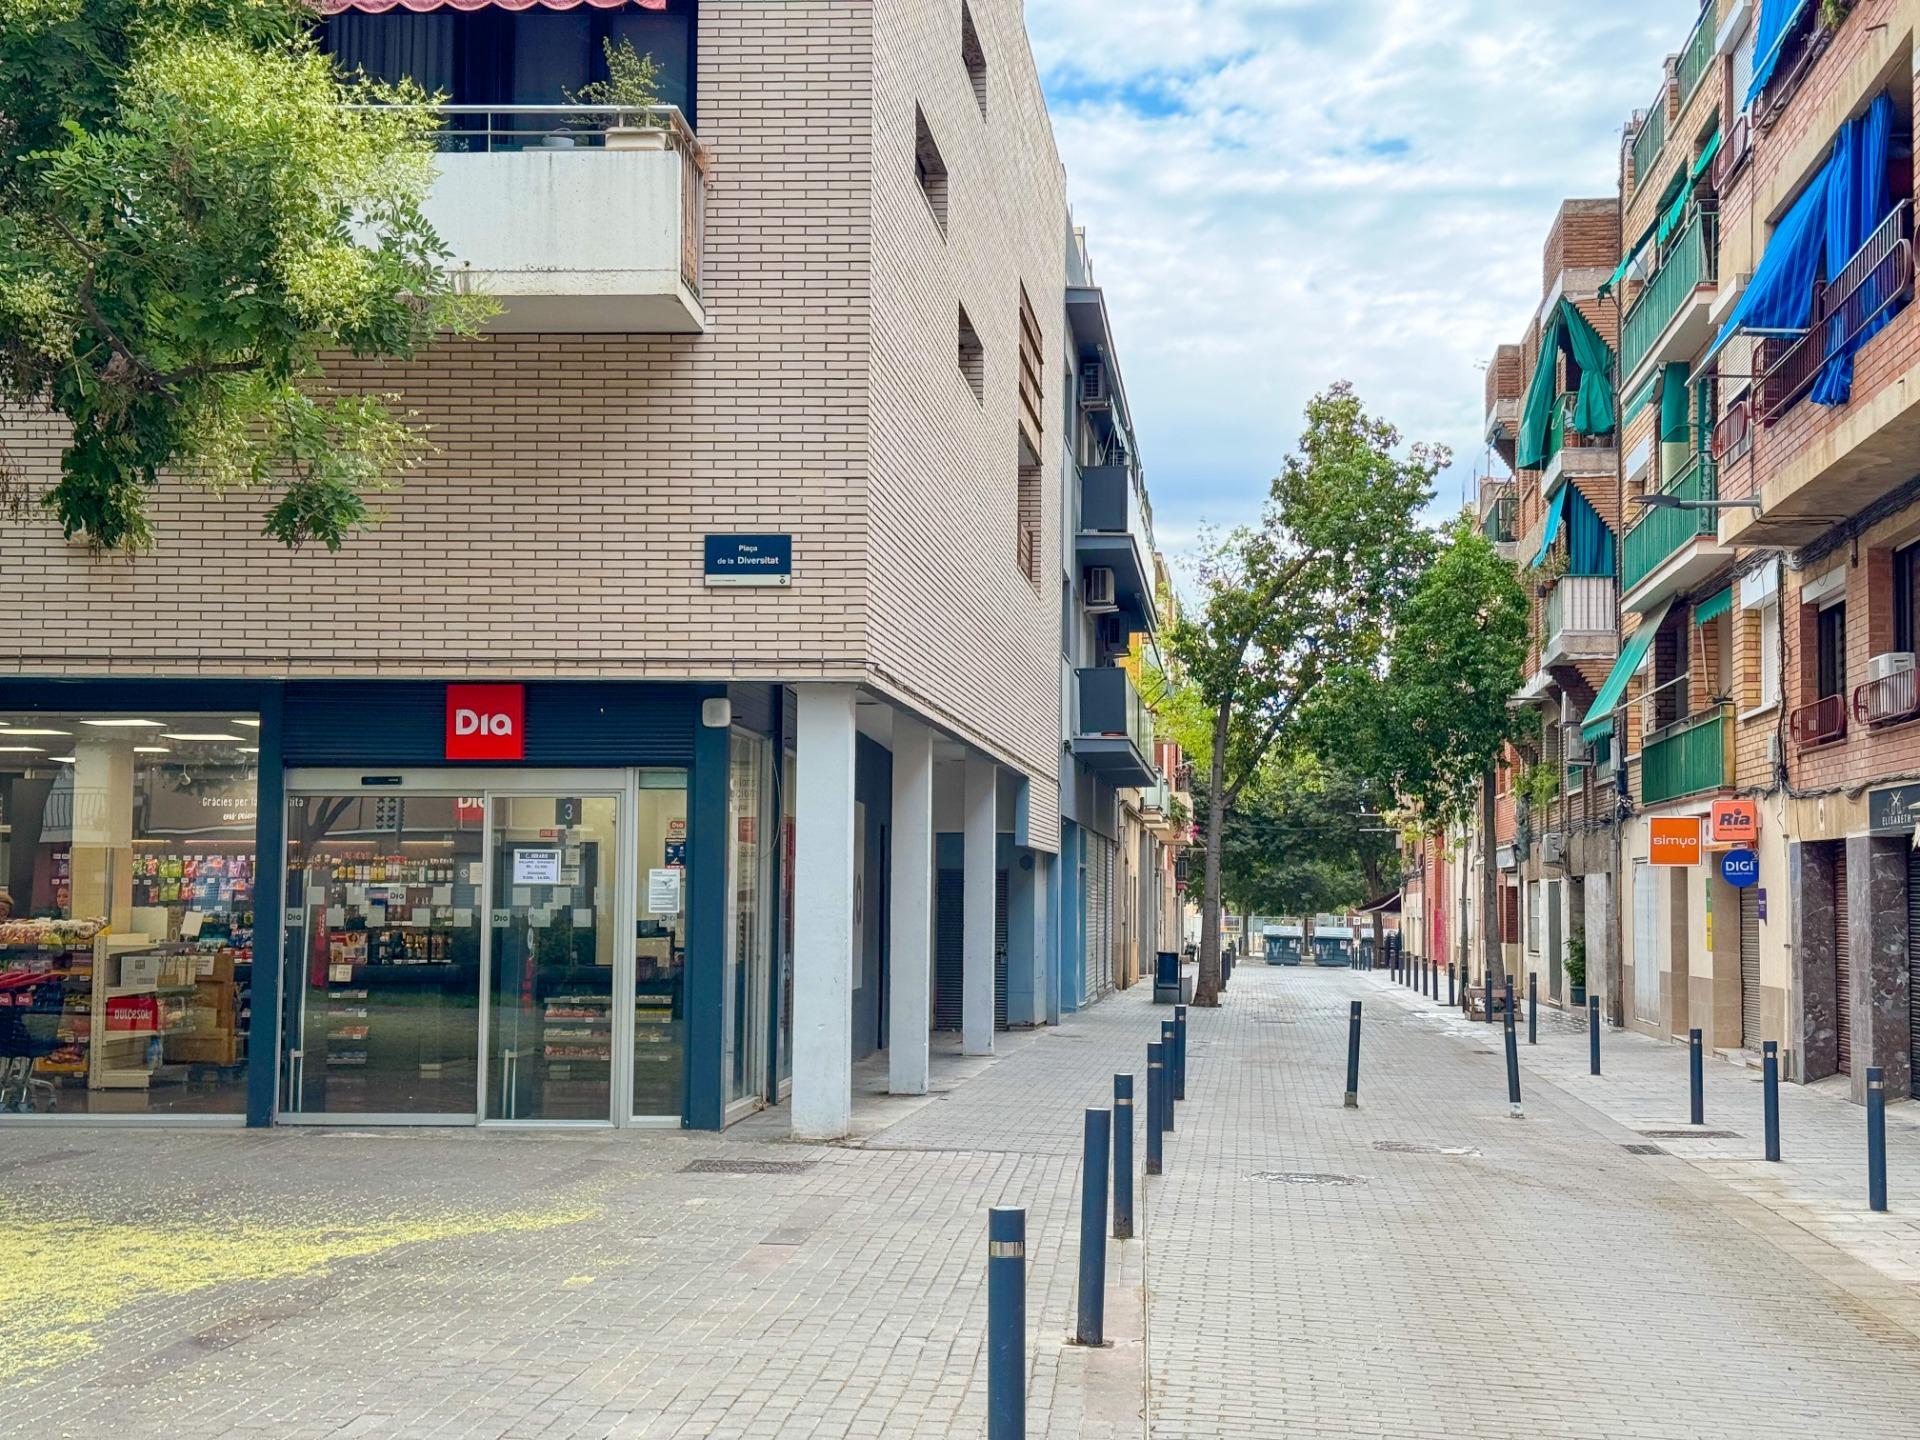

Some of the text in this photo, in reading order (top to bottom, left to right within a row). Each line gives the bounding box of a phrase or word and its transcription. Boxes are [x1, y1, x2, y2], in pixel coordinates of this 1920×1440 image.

[738, 544, 758, 553] Plaça
[717, 556, 779, 565] de la Diversitat
[455, 708, 513, 736] Dia
[202, 796, 233, 807] Gràcies
[234, 798, 248, 809] per
[564, 803, 574, 820] 3
[1719, 808, 1751, 826] Ria
[1881, 813, 1912, 827] ELISABETH
[1652, 834, 1697, 848] simyo
[1725, 861, 1754, 871] DIGI
[389, 891, 405, 899] Dia
[286, 913, 302, 921] Dia
[493, 914, 509, 922] Dia
